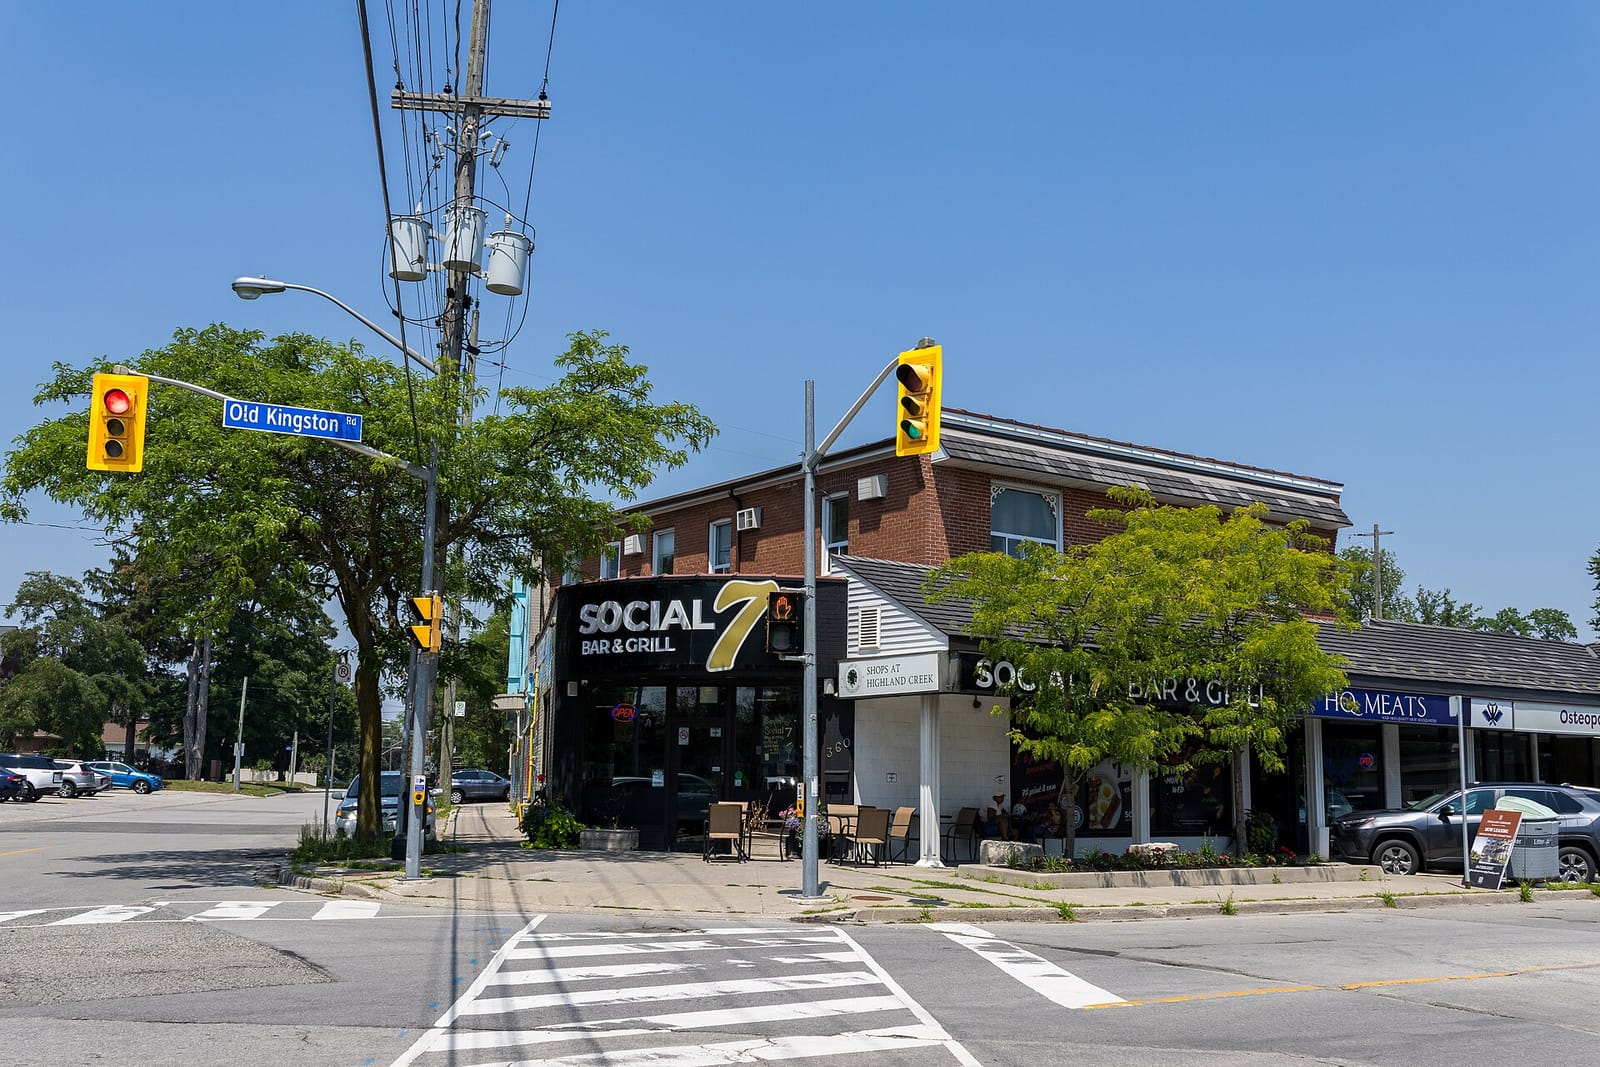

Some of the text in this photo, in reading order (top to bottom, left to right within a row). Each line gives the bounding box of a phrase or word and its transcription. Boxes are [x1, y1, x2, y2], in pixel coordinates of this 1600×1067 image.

[229, 403, 357, 433] Old Kingston Rd
[579, 580, 780, 672] SOCIAL 7
[581, 636, 677, 655] BAR & GRILL
[866, 663, 901, 676] SHOPS AT
[866, 673, 934, 688] HIGHLAND CREEK
[976, 658, 1076, 693] SOCA
[1128, 675, 1178, 701] BAR
[1184, 677, 1200, 703] &
[1325, 690, 1427, 718] HQ MEATS
[826, 737, 851, 758] 360
